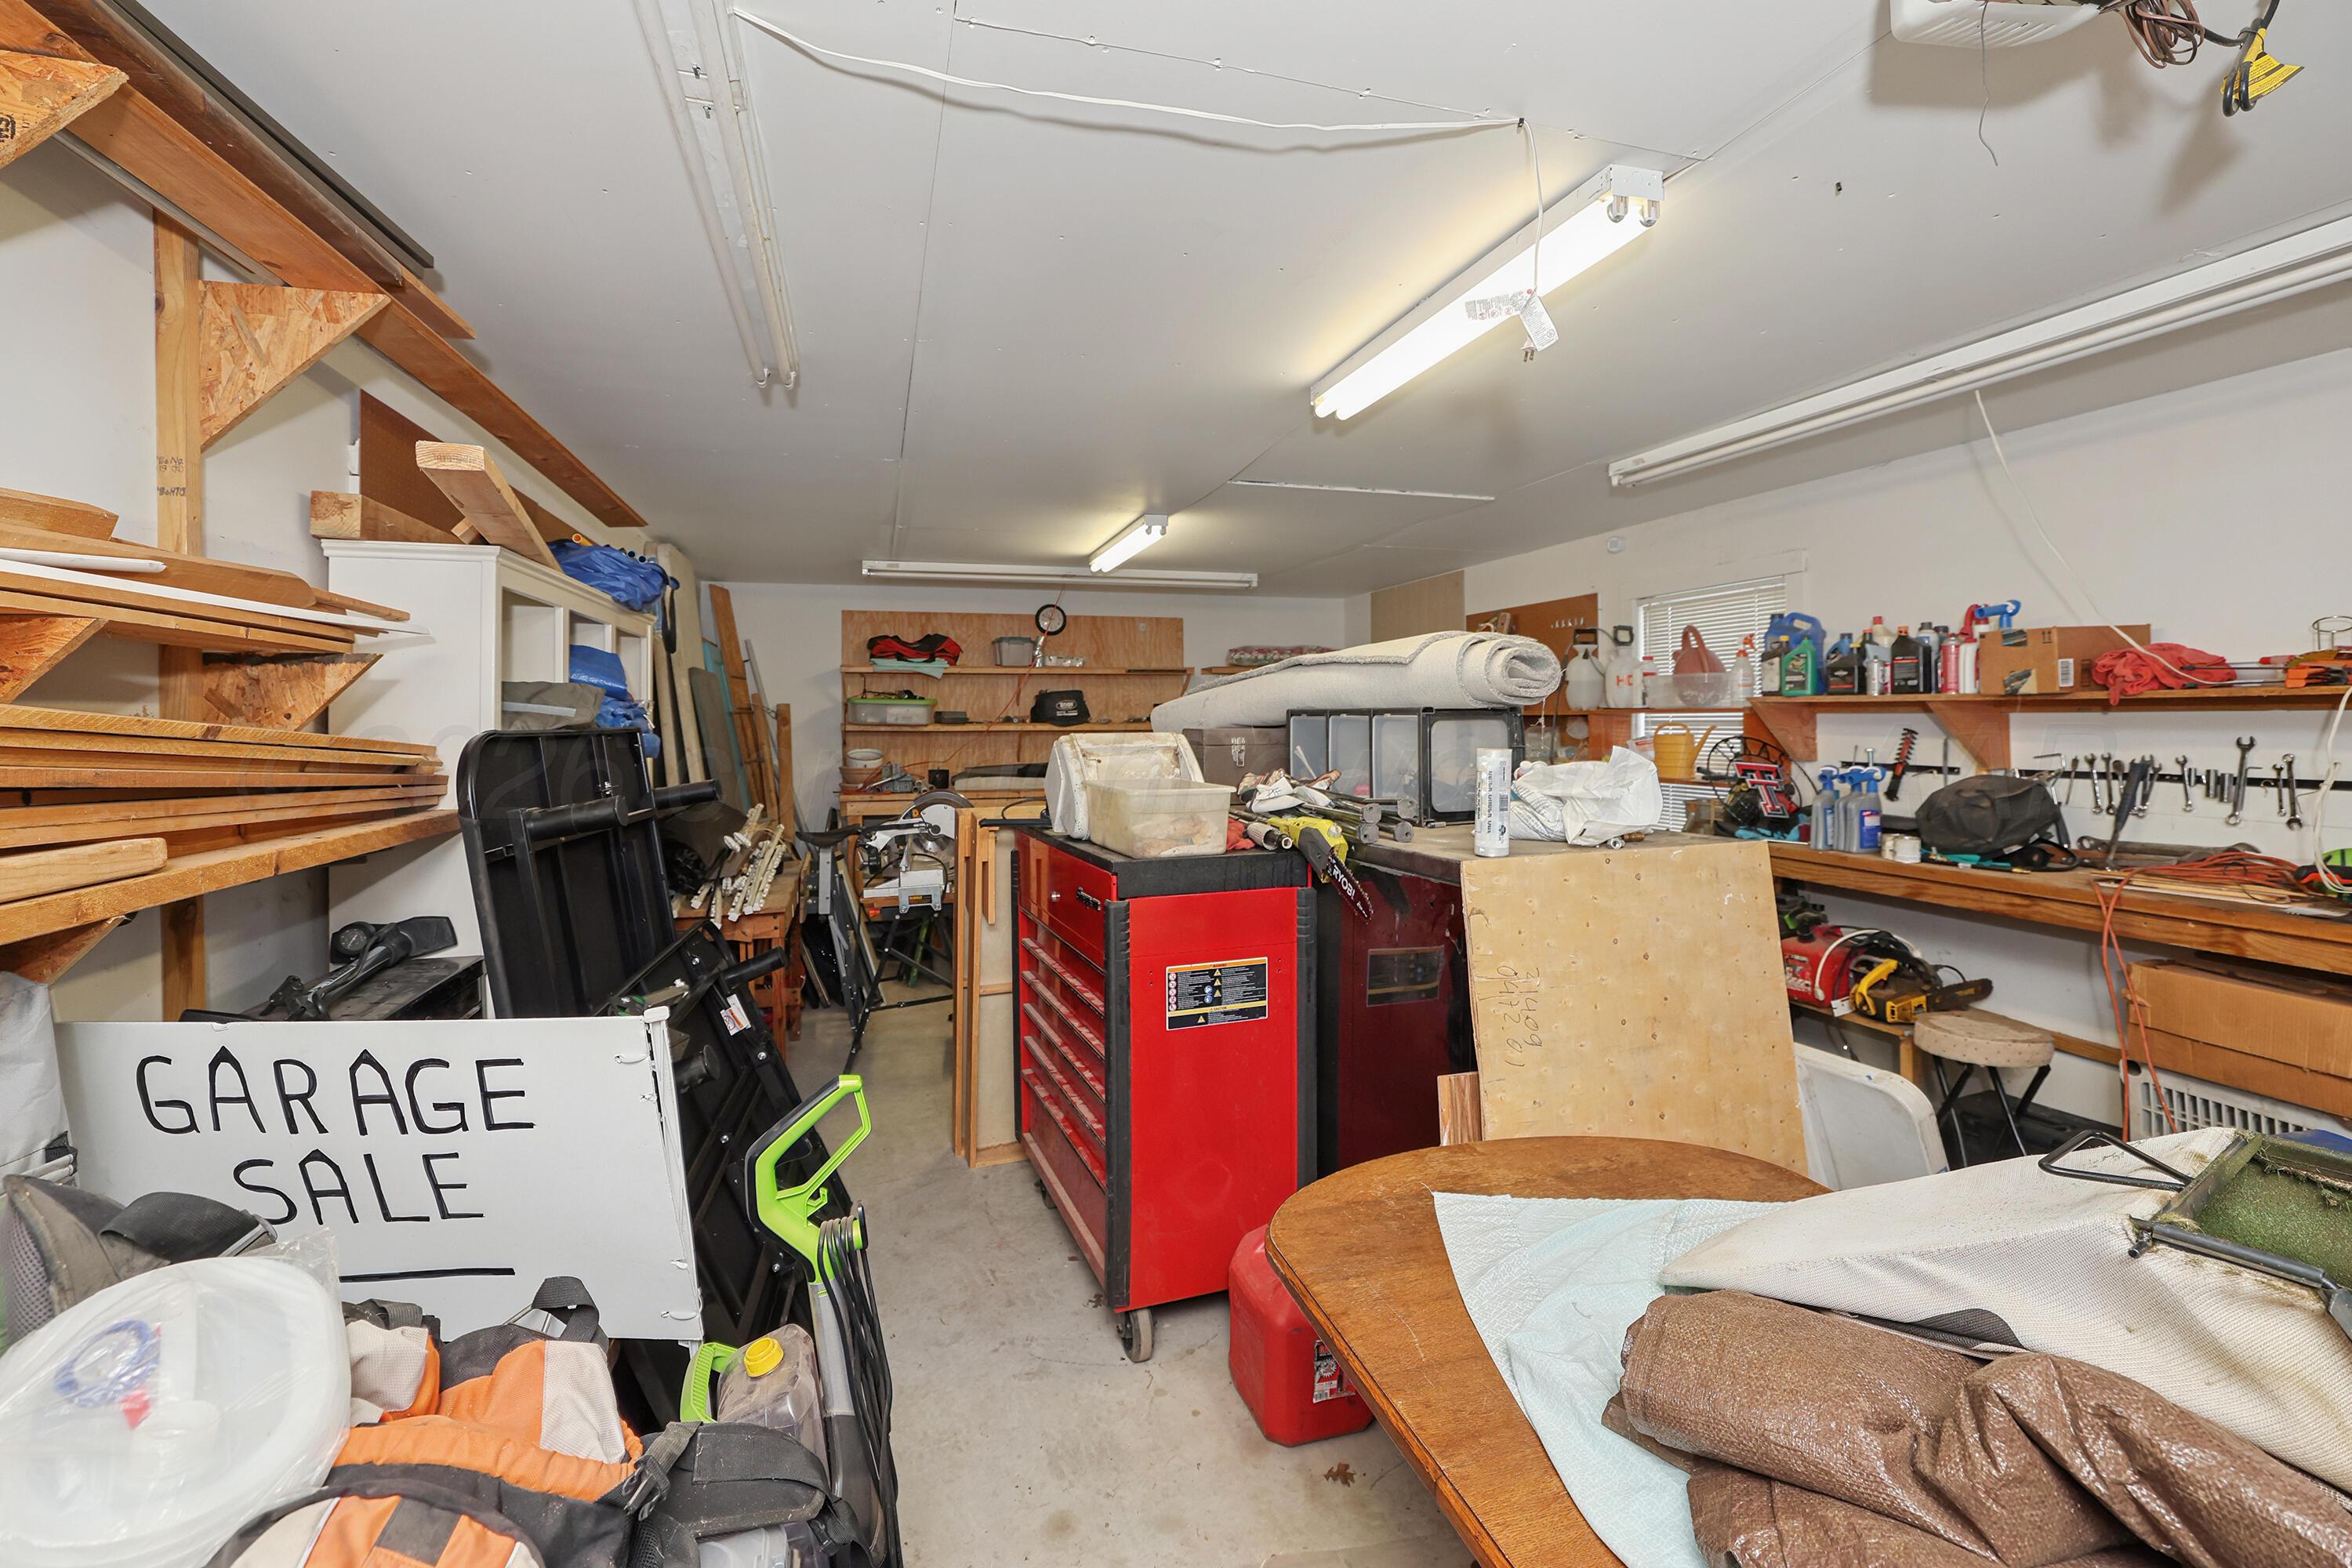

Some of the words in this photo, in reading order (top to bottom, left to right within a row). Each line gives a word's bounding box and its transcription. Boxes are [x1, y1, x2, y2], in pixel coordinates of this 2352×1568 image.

[1332, 864, 1356, 900] RYOBI
[136, 1046, 536, 1136] GARAGE
[233, 1148, 485, 1226] SALE
